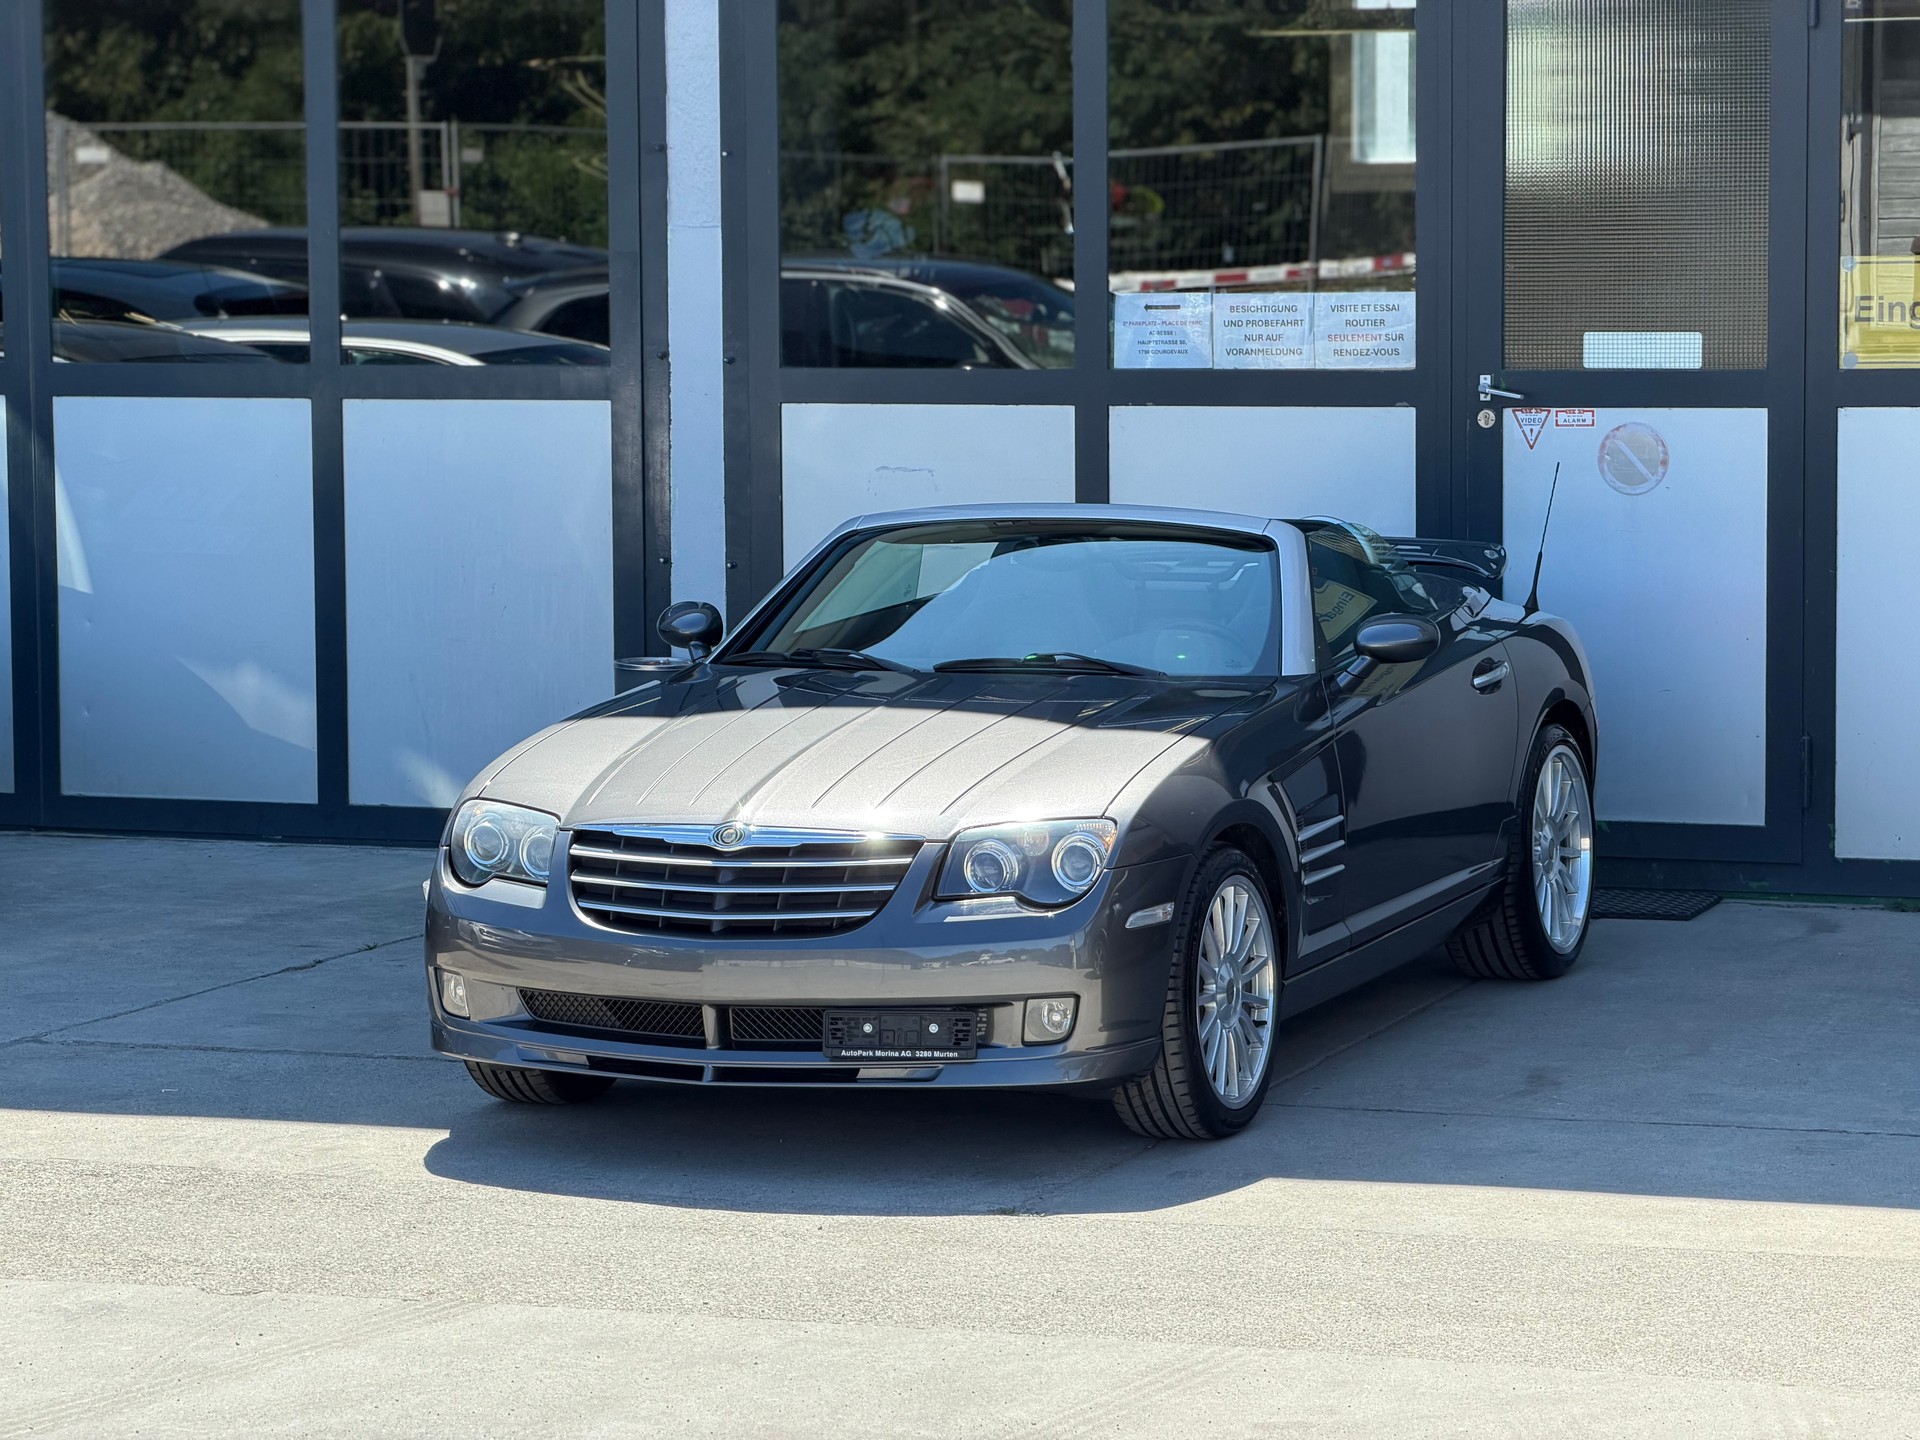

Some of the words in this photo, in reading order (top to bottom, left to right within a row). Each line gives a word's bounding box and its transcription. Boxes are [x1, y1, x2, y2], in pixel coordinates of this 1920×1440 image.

[1229, 304, 1298, 314] BESICHTIGUNG
[1330, 304, 1358, 313] VISITE
[1361, 304, 1371, 313] ET
[1373, 303, 1400, 313] ESSAI
[1223, 319, 1244, 328] UND
[1245, 319, 1305, 328] PROBEFAHRT
[1345, 318, 1386, 328] ROUTIER
[1244, 333, 1264, 342] NUR
[1265, 333, 1284, 342] AUF
[1327, 334, 1382, 342] SEULEMENT
[1384, 333, 1405, 342] SUR
[1225, 348, 1303, 356] VORANMELDUNG
[1333, 348, 1400, 356] RENDEZ-VOUS
[840, 1049, 874, 1057] AutoPark
[875, 1049, 900, 1058] Morina
[900, 1050, 912, 1058] AG
[915, 1050, 932, 1058] 3280
